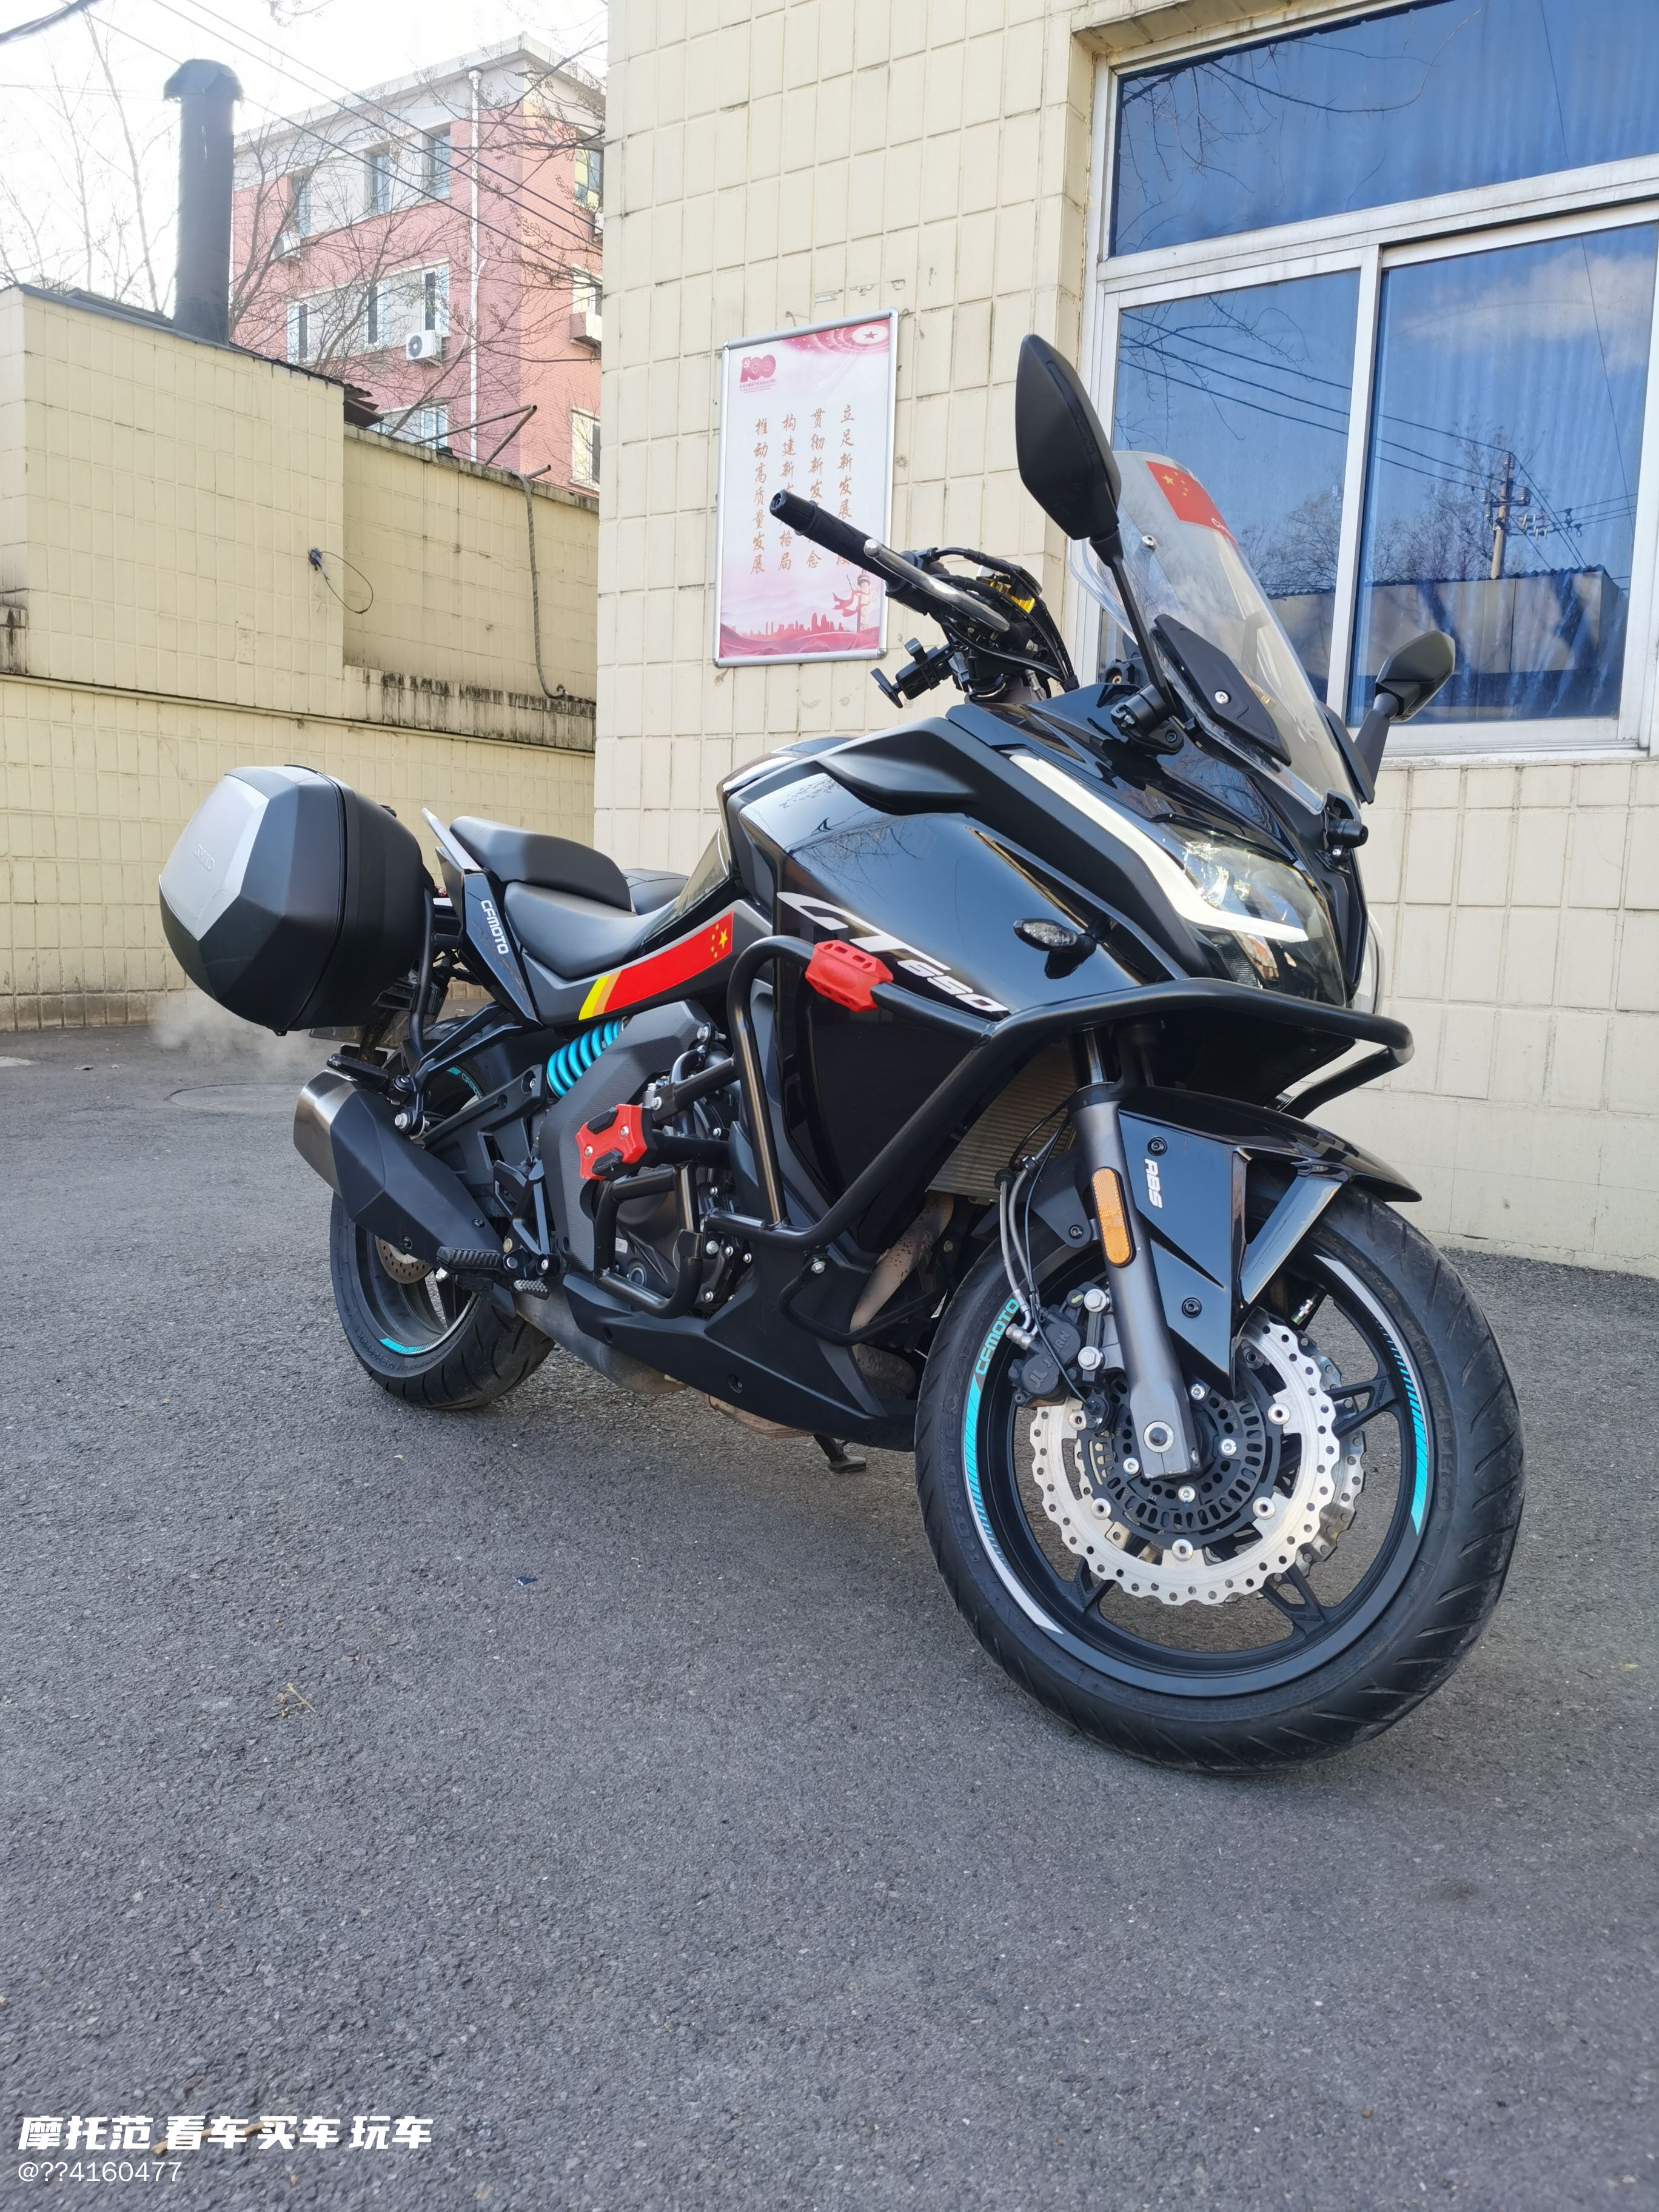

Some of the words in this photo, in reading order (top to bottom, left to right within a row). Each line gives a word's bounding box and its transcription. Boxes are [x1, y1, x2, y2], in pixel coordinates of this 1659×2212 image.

[750, 418, 769, 574] 推动高质量发展
[778, 414, 797, 571] 构建新格局
[805, 407, 825, 569] 贯彻新发念
[835, 404, 855, 566] 立足新发展
[480, 900, 509, 954] CFMOTO
[897, 959, 1010, 1012] 650
[1144, 1158, 1163, 1208] ABS
[975, 1299, 1019, 1375] CFMOTO
